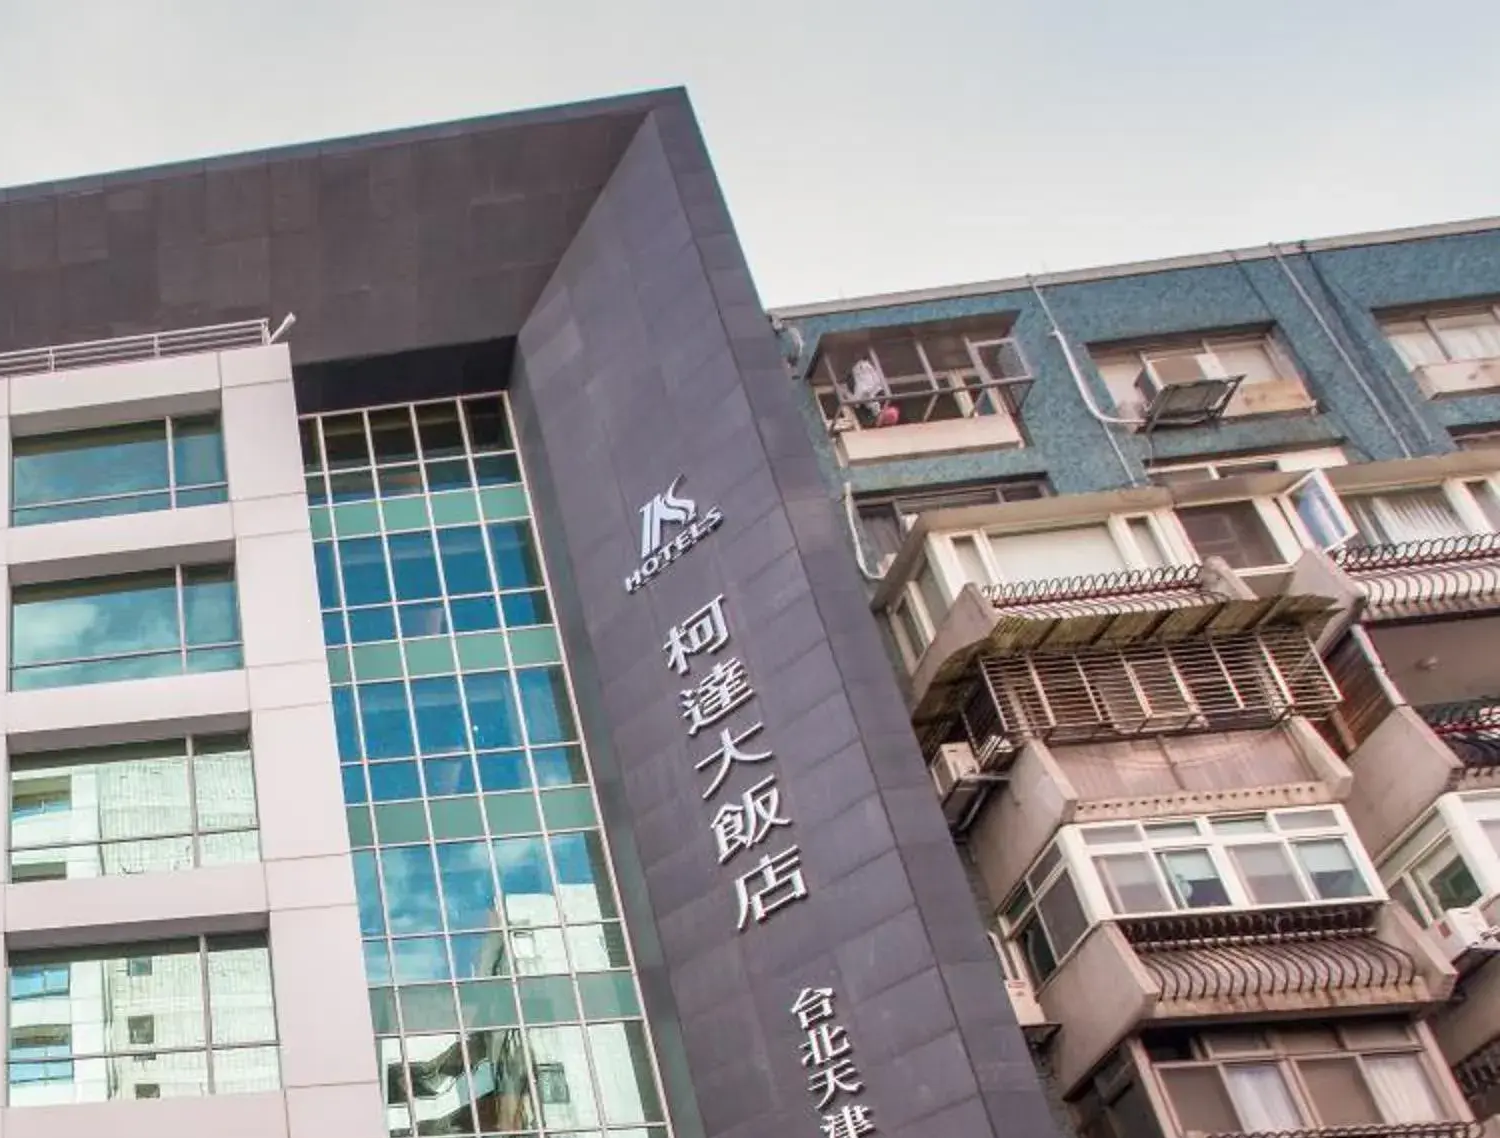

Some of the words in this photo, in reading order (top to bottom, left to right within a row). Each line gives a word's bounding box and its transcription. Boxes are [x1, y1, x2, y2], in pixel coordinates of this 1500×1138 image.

[625, 506, 723, 592] HOTELS
[662, 593, 809, 930] 柯達大飯店
